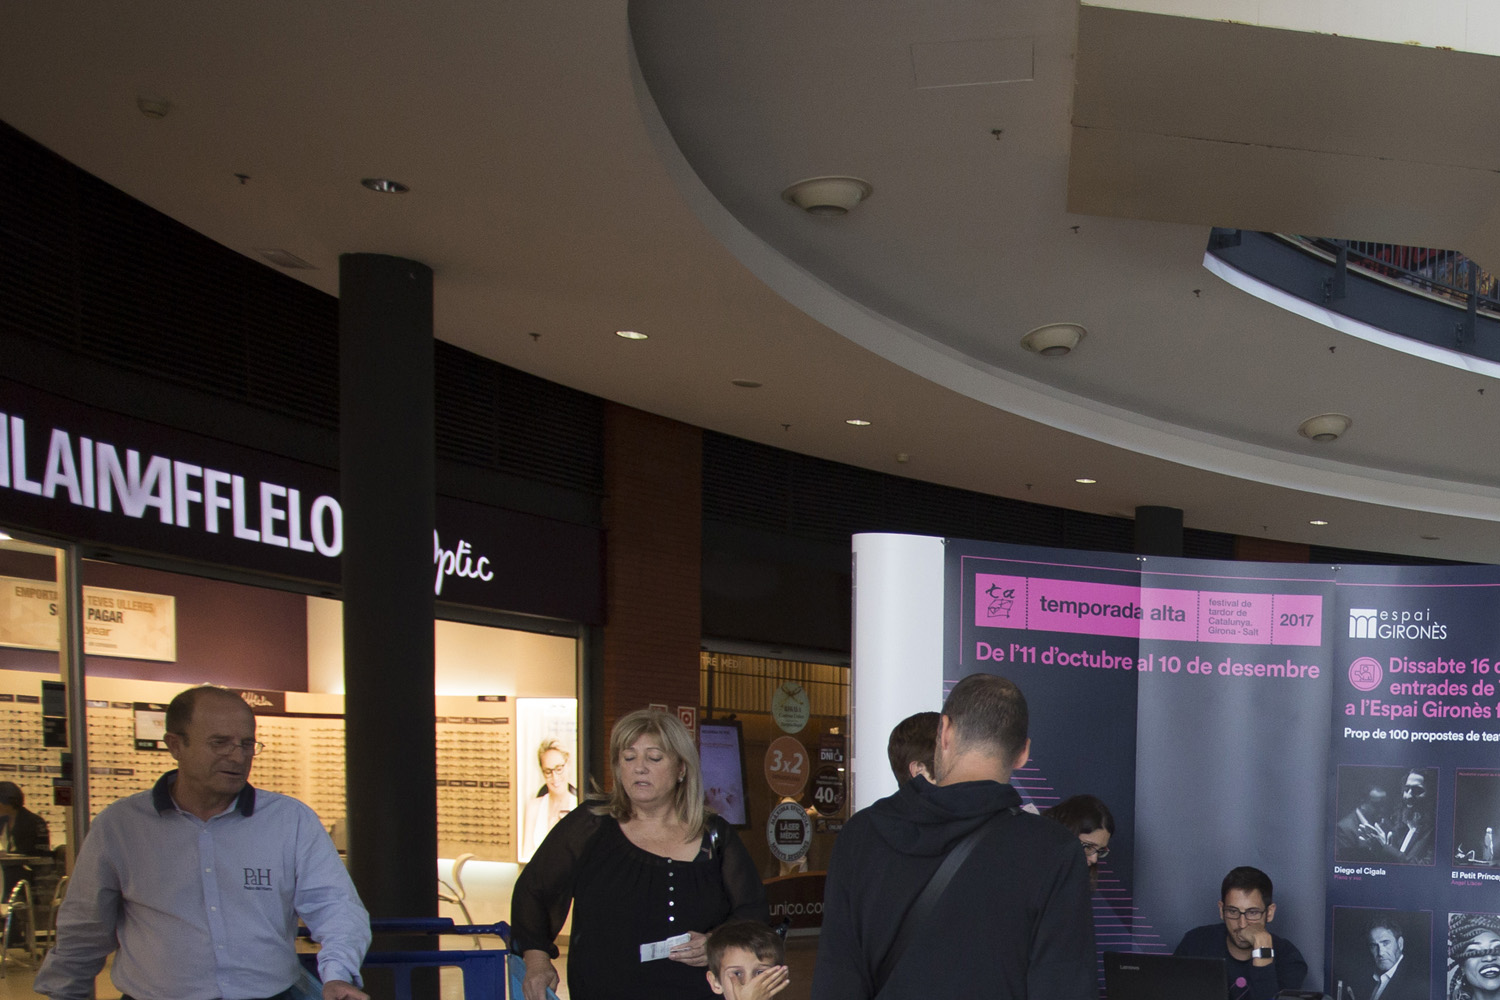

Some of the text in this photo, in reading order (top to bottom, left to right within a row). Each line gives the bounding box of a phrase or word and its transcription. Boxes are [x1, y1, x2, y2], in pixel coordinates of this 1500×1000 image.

[87, 595, 115, 608] TEVES
[117, 597, 155, 613] ULLERES
[1039, 595, 1186, 622] temporada alta
[1208, 598, 1252, 608] festival de
[87, 608, 124, 624] PAGAR
[1208, 608, 1247, 617] tardor de
[1279, 613, 1314, 627] 2017
[1379, 608, 1430, 624] espai
[1208, 627, 1236, 635] Girona
[1242, 628, 1259, 636] Salt
[1378, 622, 1448, 640] GIRONÈS
[976, 641, 1320, 679] De l'11 d'octubre al 10 de desembre
[1389, 656, 1466, 674] Dissabte
[1471, 658, 1490, 674] 16
[1389, 679, 1468, 696] entrades
[1471, 679, 1495, 696] de
[1344, 703, 1356, 716] a
[1360, 699, 1418, 721] l'Espai
[1422, 700, 1492, 718] Gironès
[1344, 727, 1371, 741] Prop
[1372, 728, 1387, 740] de
[1388, 729, 1409, 740] 100
[1411, 730, 1464, 743] propostes
[1466, 730, 1480, 742] de
[1334, 866, 1386, 877] Diego el Cigala
[1451, 871, 1458, 879] El
[1459, 872, 1477, 880] Petit
